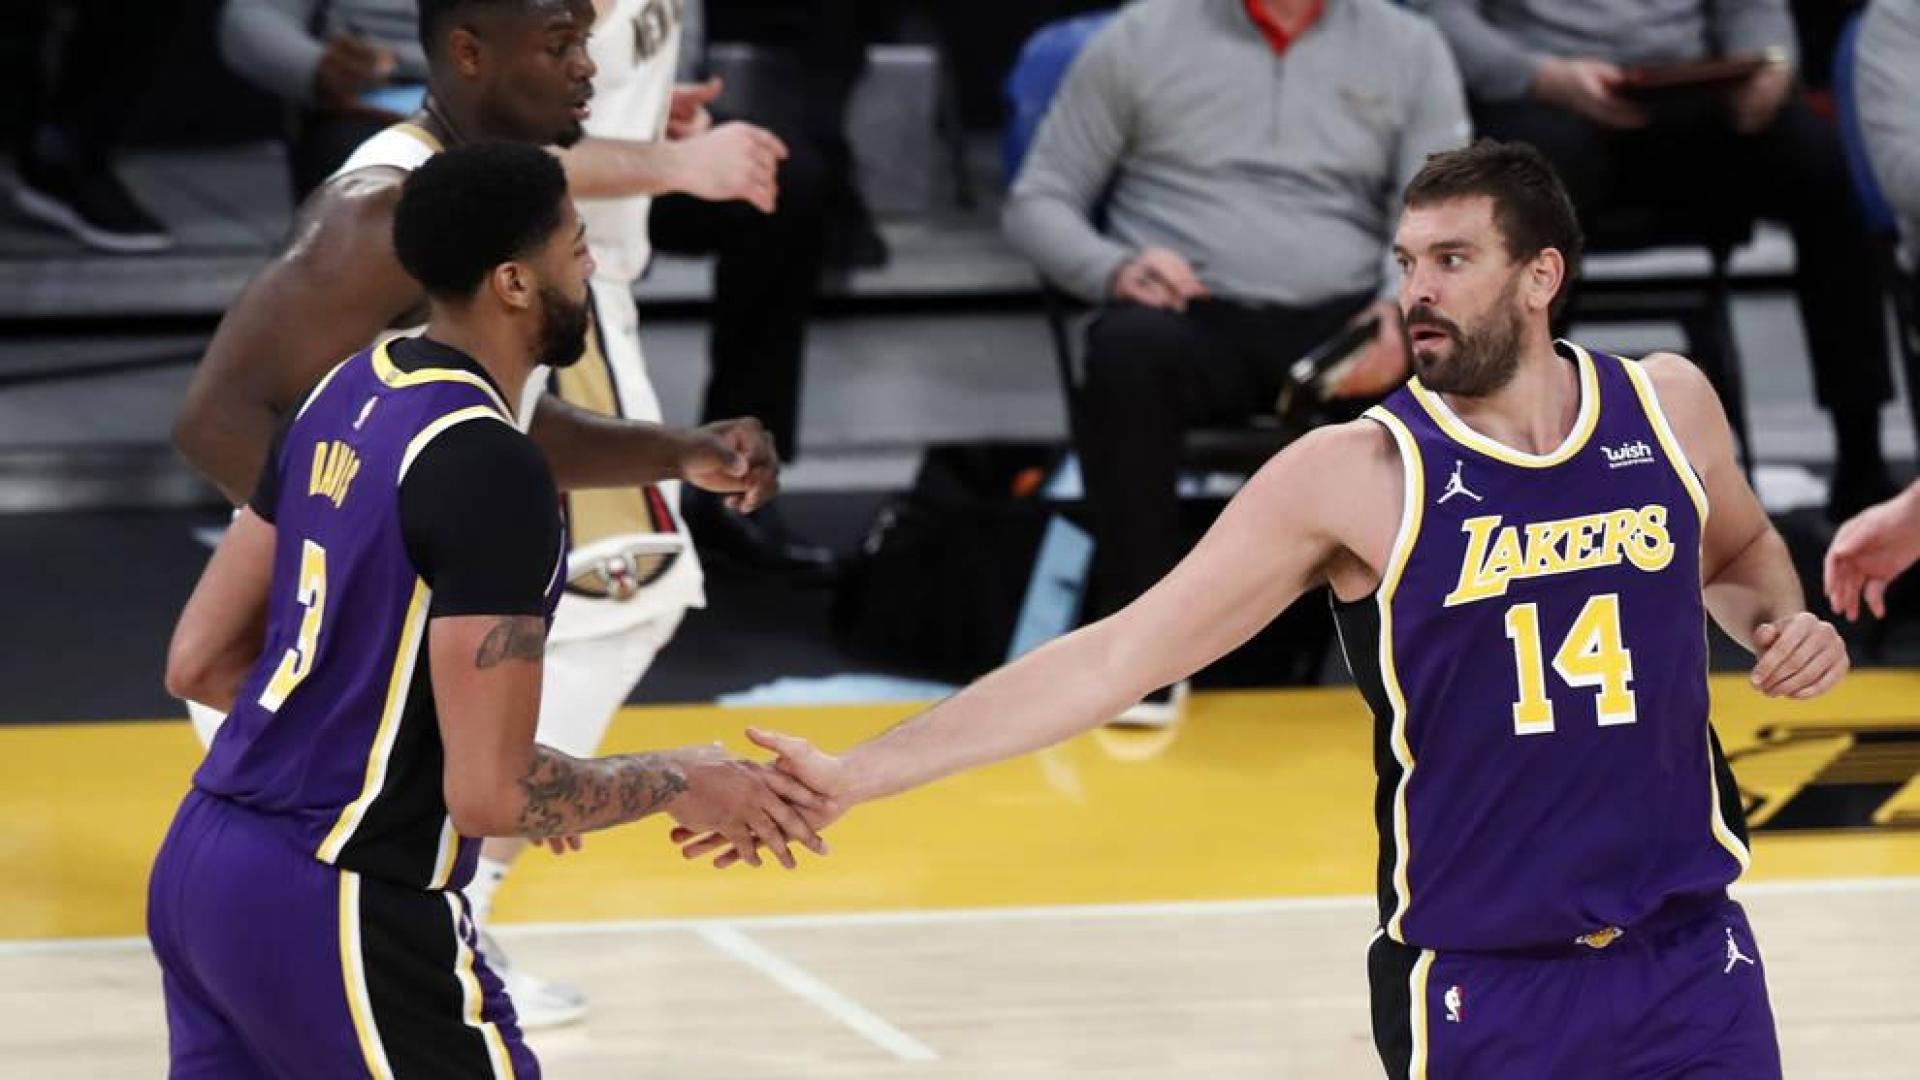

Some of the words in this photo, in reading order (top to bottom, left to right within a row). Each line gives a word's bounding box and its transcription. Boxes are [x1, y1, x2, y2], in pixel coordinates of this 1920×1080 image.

[1600, 441, 1652, 461] wish
[1443, 504, 1675, 608] LAKERS
[257, 538, 327, 713] 3
[1504, 592, 1638, 736] 14
